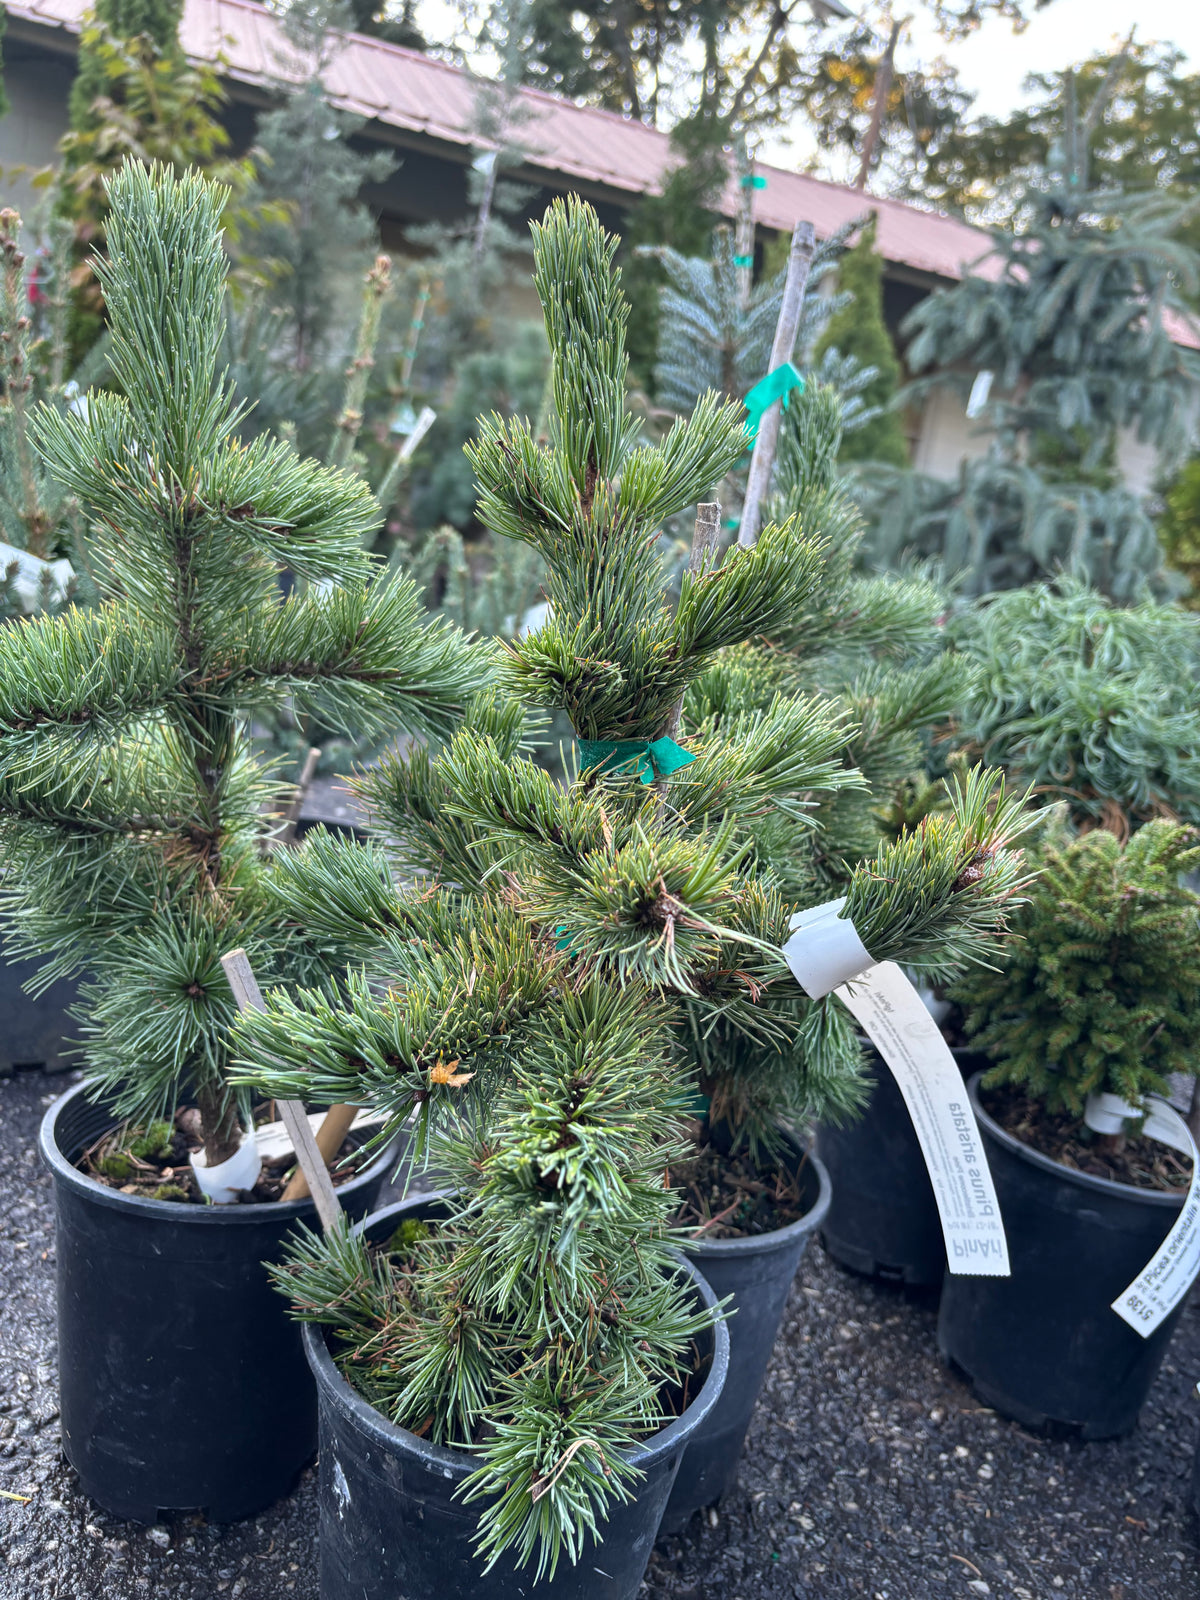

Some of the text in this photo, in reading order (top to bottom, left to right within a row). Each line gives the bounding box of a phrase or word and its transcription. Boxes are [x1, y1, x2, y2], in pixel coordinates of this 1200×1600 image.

[1143, 1255, 1170, 1286] Picea
[1168, 1204, 1198, 1255] orientalis
[1126, 1295, 1154, 1321] 5139
